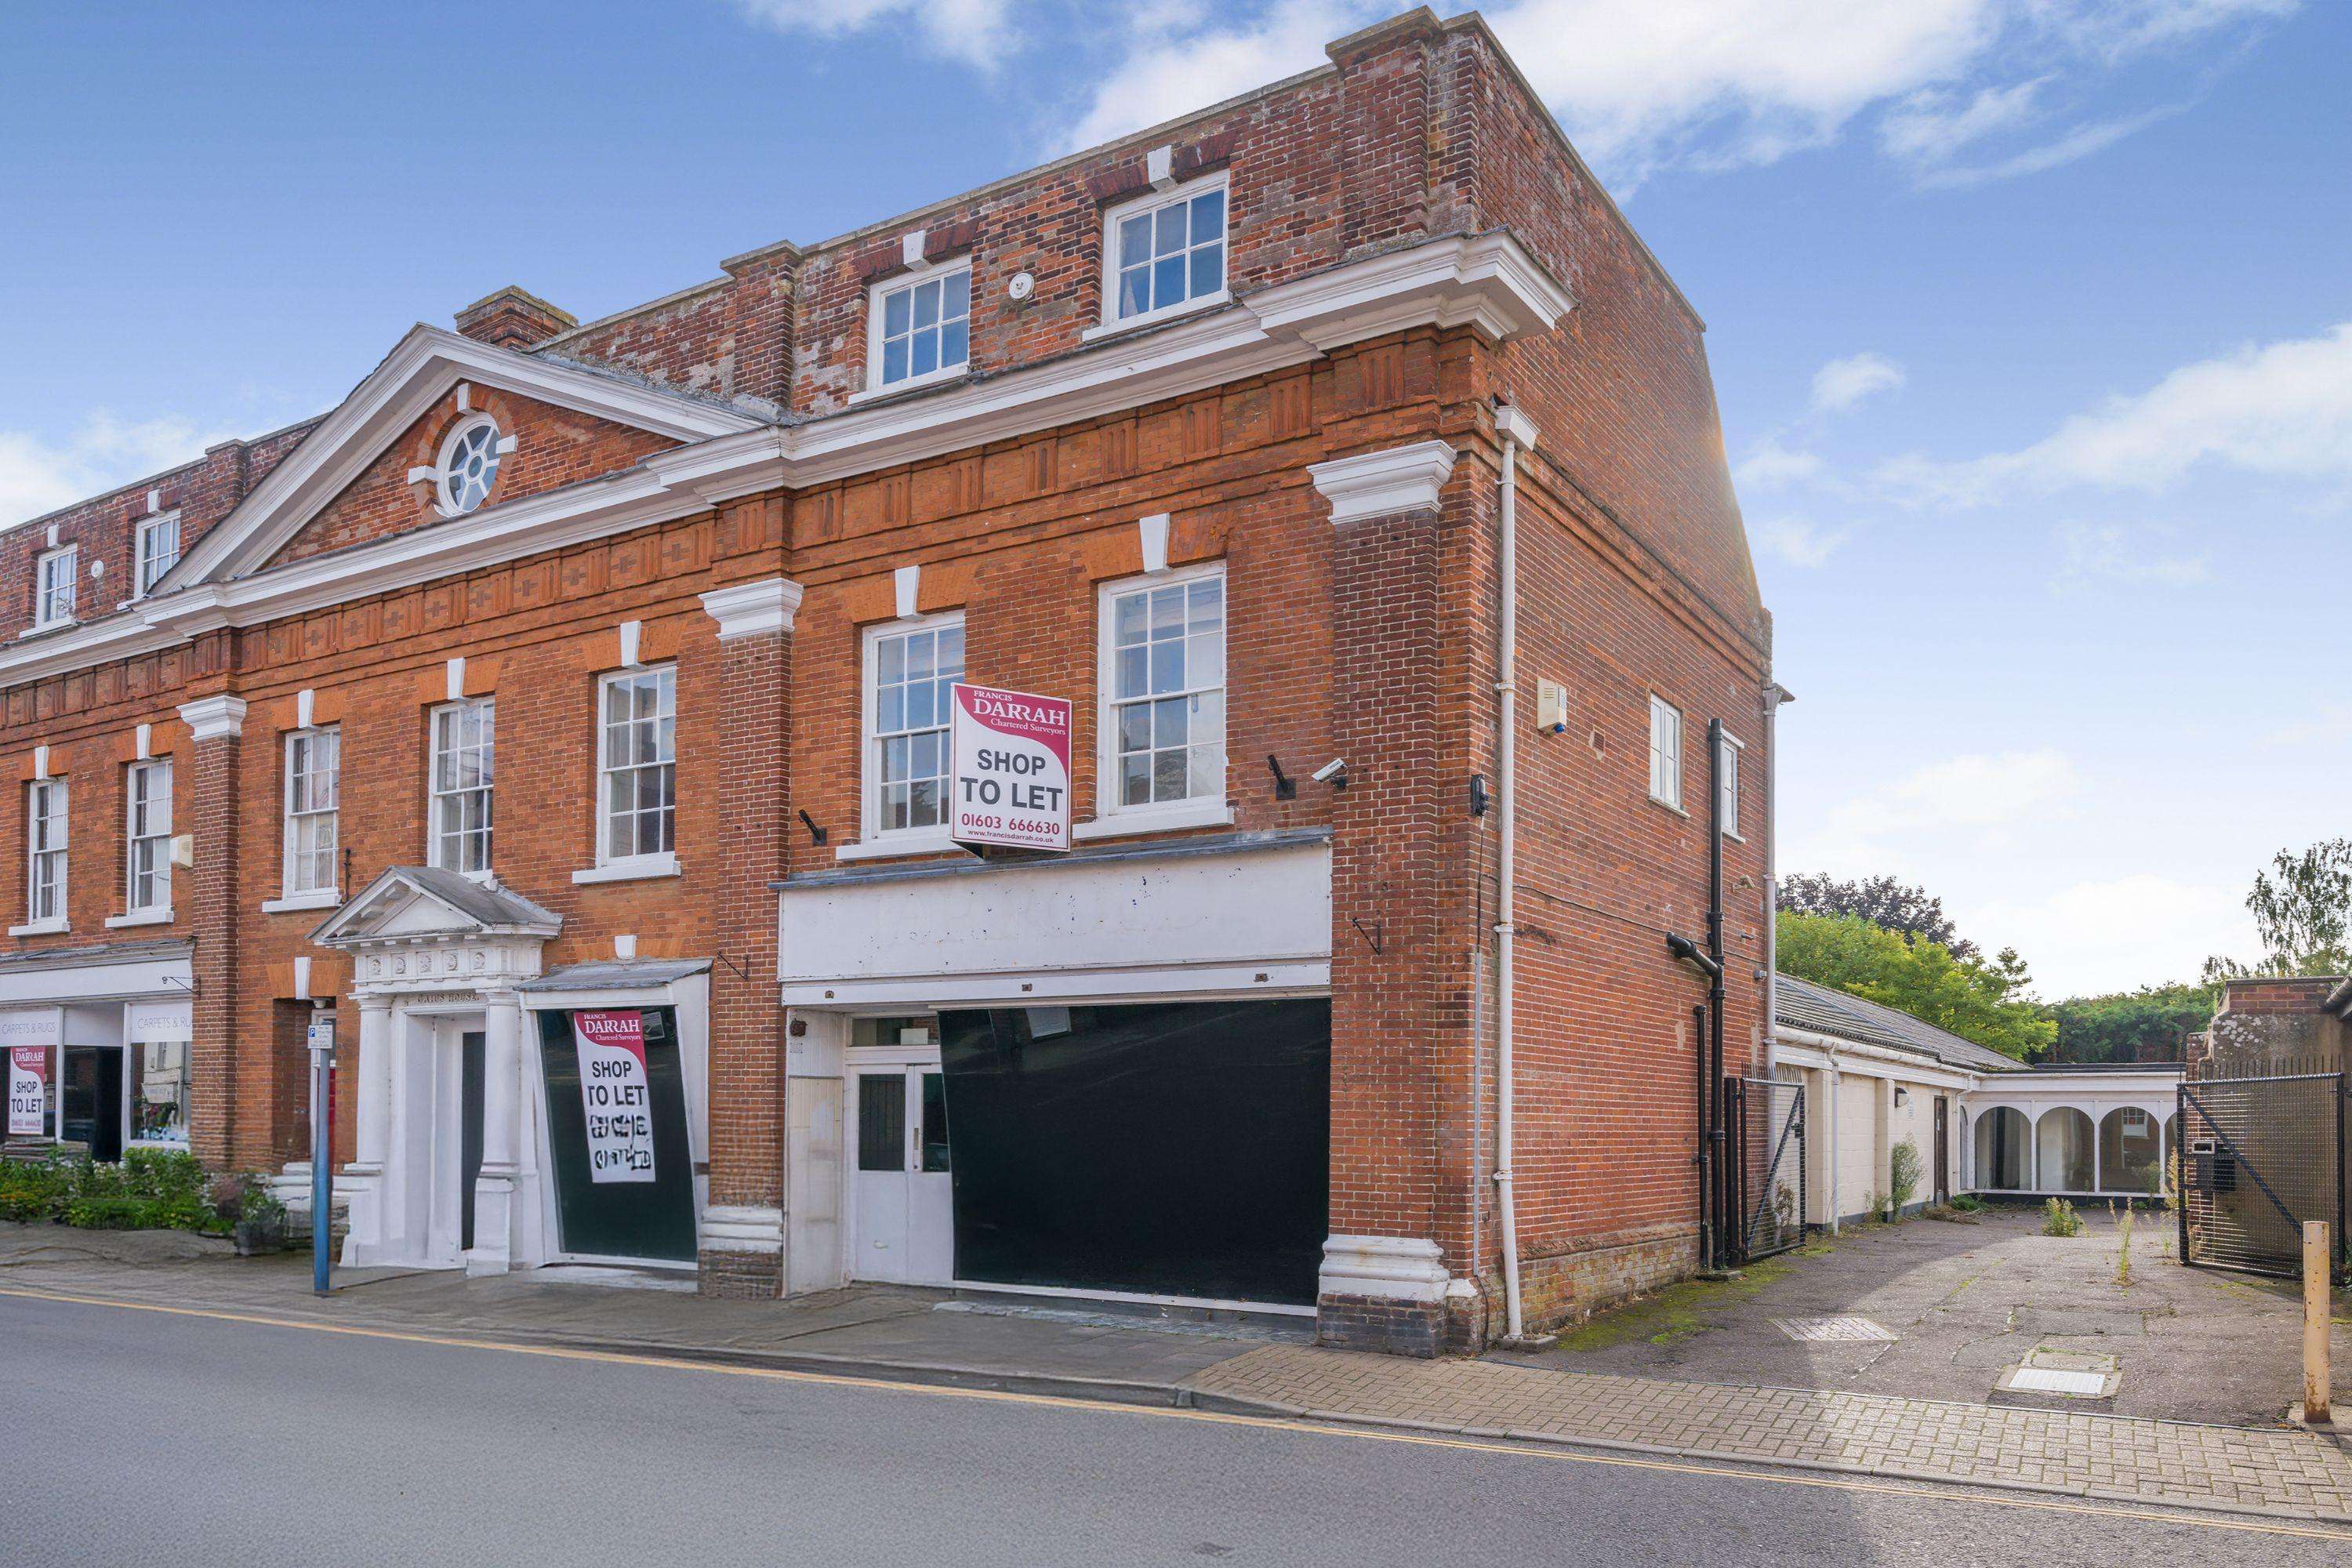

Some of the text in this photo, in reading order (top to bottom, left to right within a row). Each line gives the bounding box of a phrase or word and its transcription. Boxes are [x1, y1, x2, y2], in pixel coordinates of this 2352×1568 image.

[974, 690, 1012, 702] FRANCIS
[973, 699, 1065, 726] DARRAH
[990, 717, 1065, 735] Chartered Surveyors
[978, 749, 1046, 775] SHOP
[960, 776, 1063, 811] TO LET
[961, 813, 1060, 835] 01603 666630
[967, 829, 1054, 844] www.francisdarrah.co.uk
[2, 1022, 56, 1035] CARPETS & RUGS
[137, 1016, 171, 1029] CARPETS
[172, 1016, 179, 1027] &
[584, 1019, 641, 1033] DARRAH
[16, 1051, 44, 1062] DARRAH
[592, 1060, 631, 1078] SHOP
[16, 1081, 38, 1094] SHOP
[587, 1085, 644, 1106] TO LET
[11, 1098, 42, 1113] TO LET
